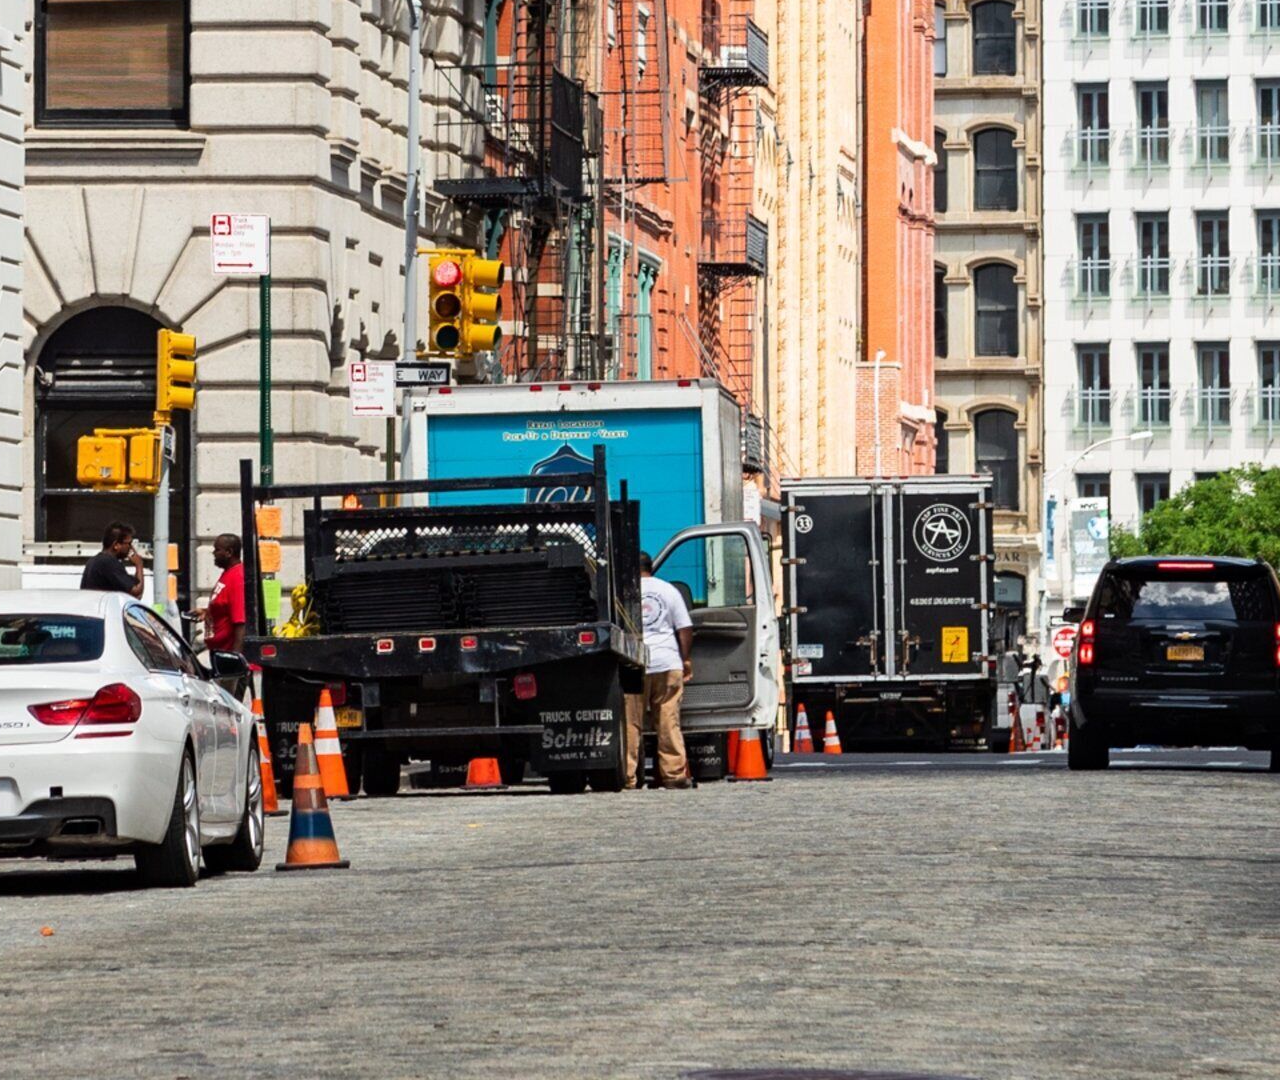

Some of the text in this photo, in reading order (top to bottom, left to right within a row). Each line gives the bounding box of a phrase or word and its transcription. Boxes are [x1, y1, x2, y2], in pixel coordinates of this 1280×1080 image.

[417, 370, 444, 381] WAY
[797, 518, 811, 530] 33
[921, 543, 951, 558] SERVICES
[539, 708, 614, 723] TRUCK CENTER
